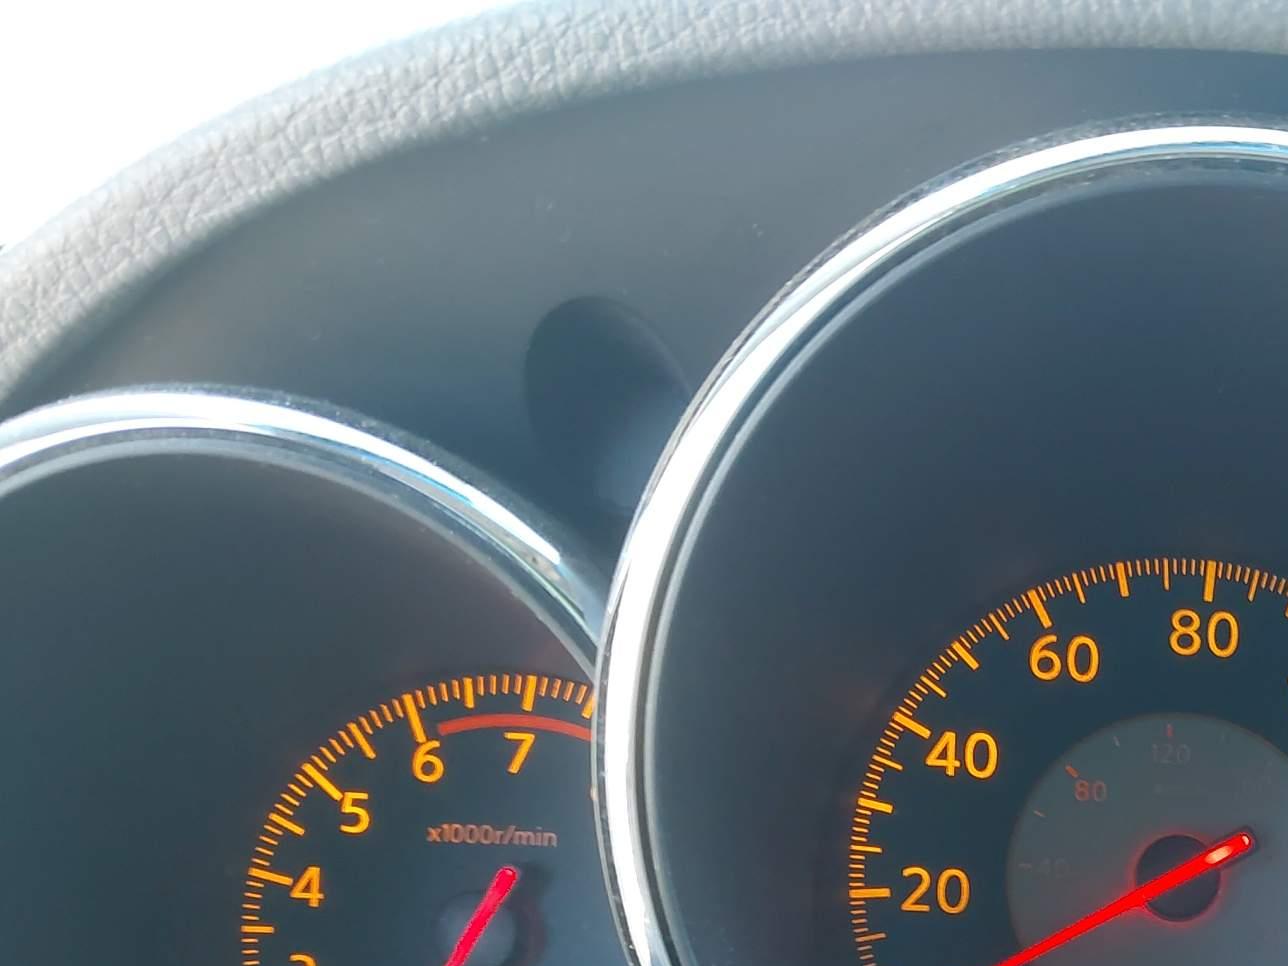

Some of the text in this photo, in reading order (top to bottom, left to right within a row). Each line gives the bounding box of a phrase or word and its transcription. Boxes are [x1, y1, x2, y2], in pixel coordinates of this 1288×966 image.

[1169, 610, 1240, 657] 80
[1029, 635, 1099, 682] 60
[412, 741, 444, 782] 6
[504, 733, 534, 774] 7
[925, 731, 999, 779] 40
[1074, 779, 1108, 802] 80
[340, 792, 370, 833] 5
[426, 823, 558, 847] x1000r/min
[290, 867, 324, 907] 4
[901, 868, 970, 914] 20
